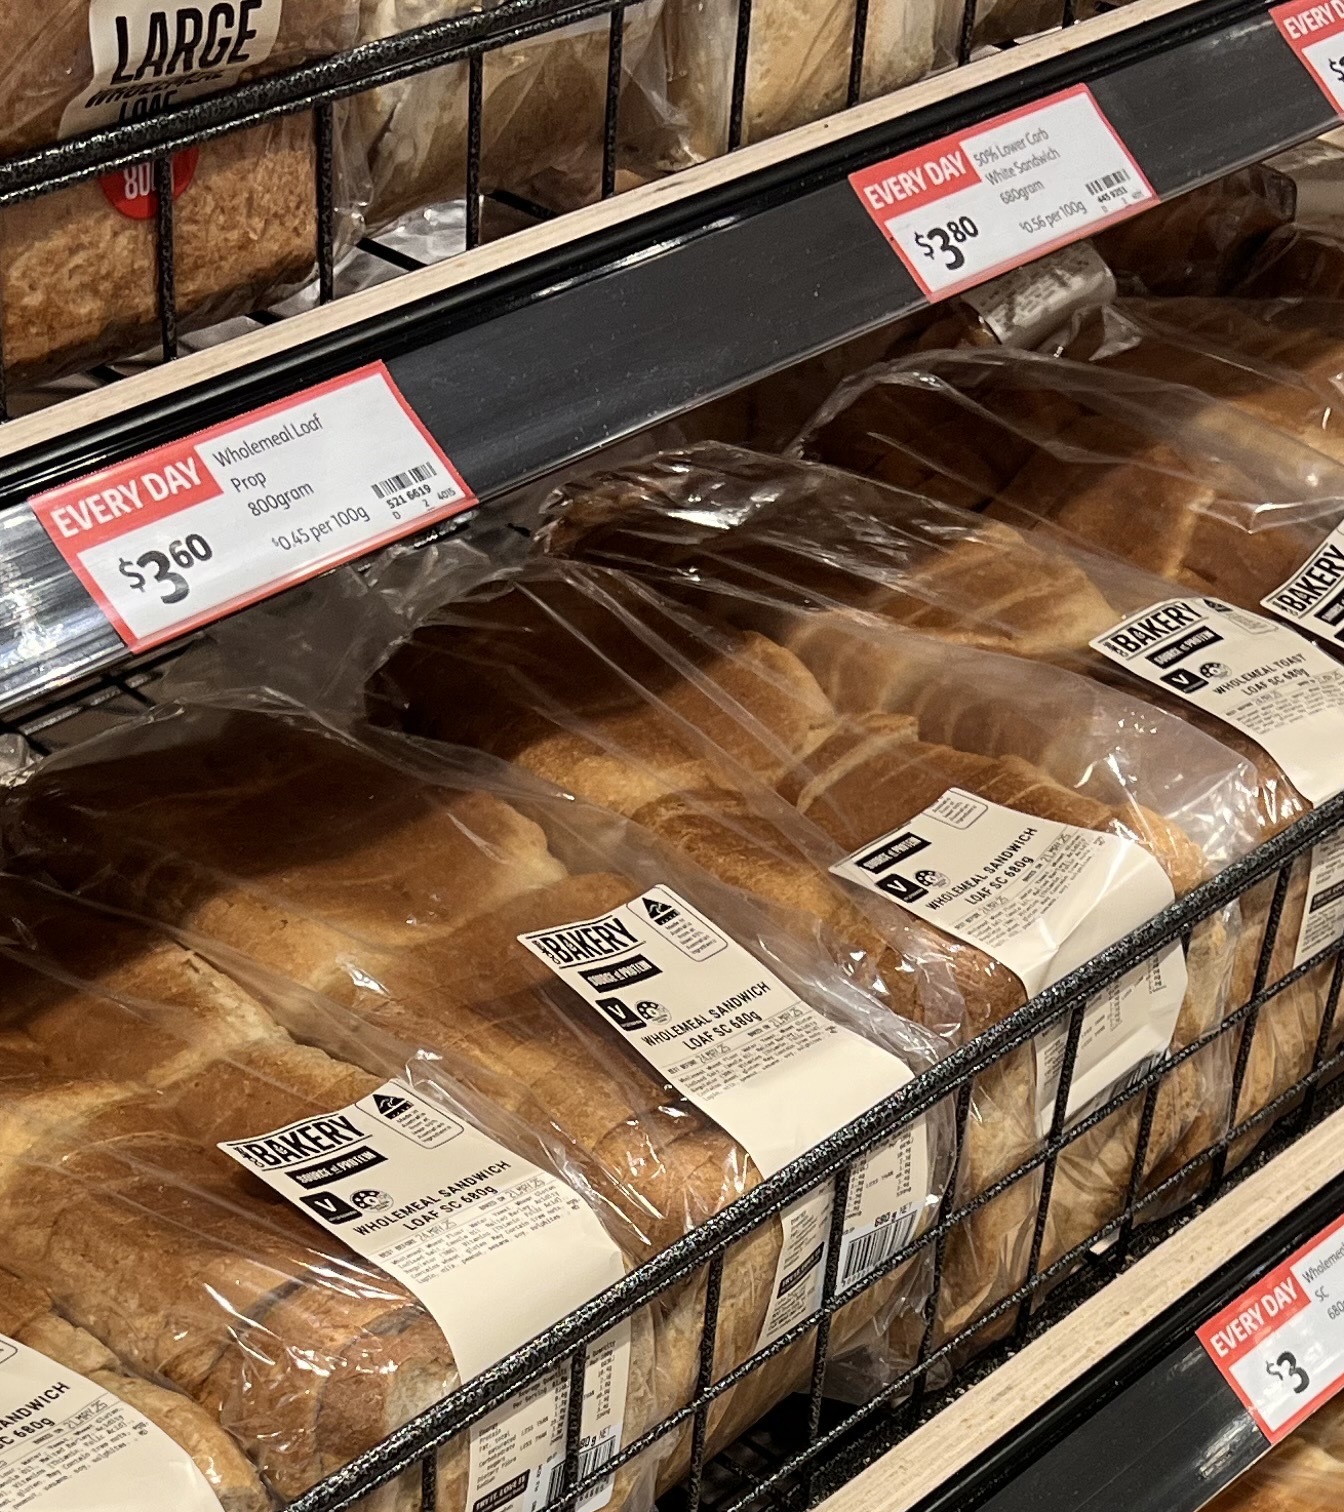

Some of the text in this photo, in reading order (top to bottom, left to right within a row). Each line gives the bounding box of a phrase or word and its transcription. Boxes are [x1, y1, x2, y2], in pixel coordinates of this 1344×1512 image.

[111, 0, 262, 85] LARGE
[1283, 4, 1335, 40] EVERY
[974, 128, 1049, 167] 50% Lower Carb
[986, 147, 1060, 187] White Sandwich
[864, 151, 967, 211] EVERY DAY
[1000, 180, 1045, 205] 680gram
[1044, 209, 1062, 228] per
[1060, 199, 1087, 220] 100g
[213, 413, 323, 468] Wholemeal Loaf
[51, 456, 202, 538] EVERY DAY
[231, 469, 267, 493] Prop
[248, 480, 314, 517] 800gram
[311, 518, 334, 542] per
[331, 504, 370, 528] 100g
[1119, 602, 1202, 654] BAKERY
[925, 826, 1037, 911] WHOLEMEAL SANDWICH
[541, 918, 638, 963] BAKERY
[641, 981, 770, 1047] WHOLEMEAL SANDWICH
[246, 1116, 364, 1167] BAKERY
[353, 1160, 511, 1236] WHOLEMEAL SANDWICH
[403, 1186, 496, 1231] LOAF SC 680g
[1315, 1285, 1330, 1302] SC
[1210, 1277, 1299, 1358] EVERY DAY
[1266, 1351, 1310, 1394] $3
[12, 1417, 55, 1443] 680g
